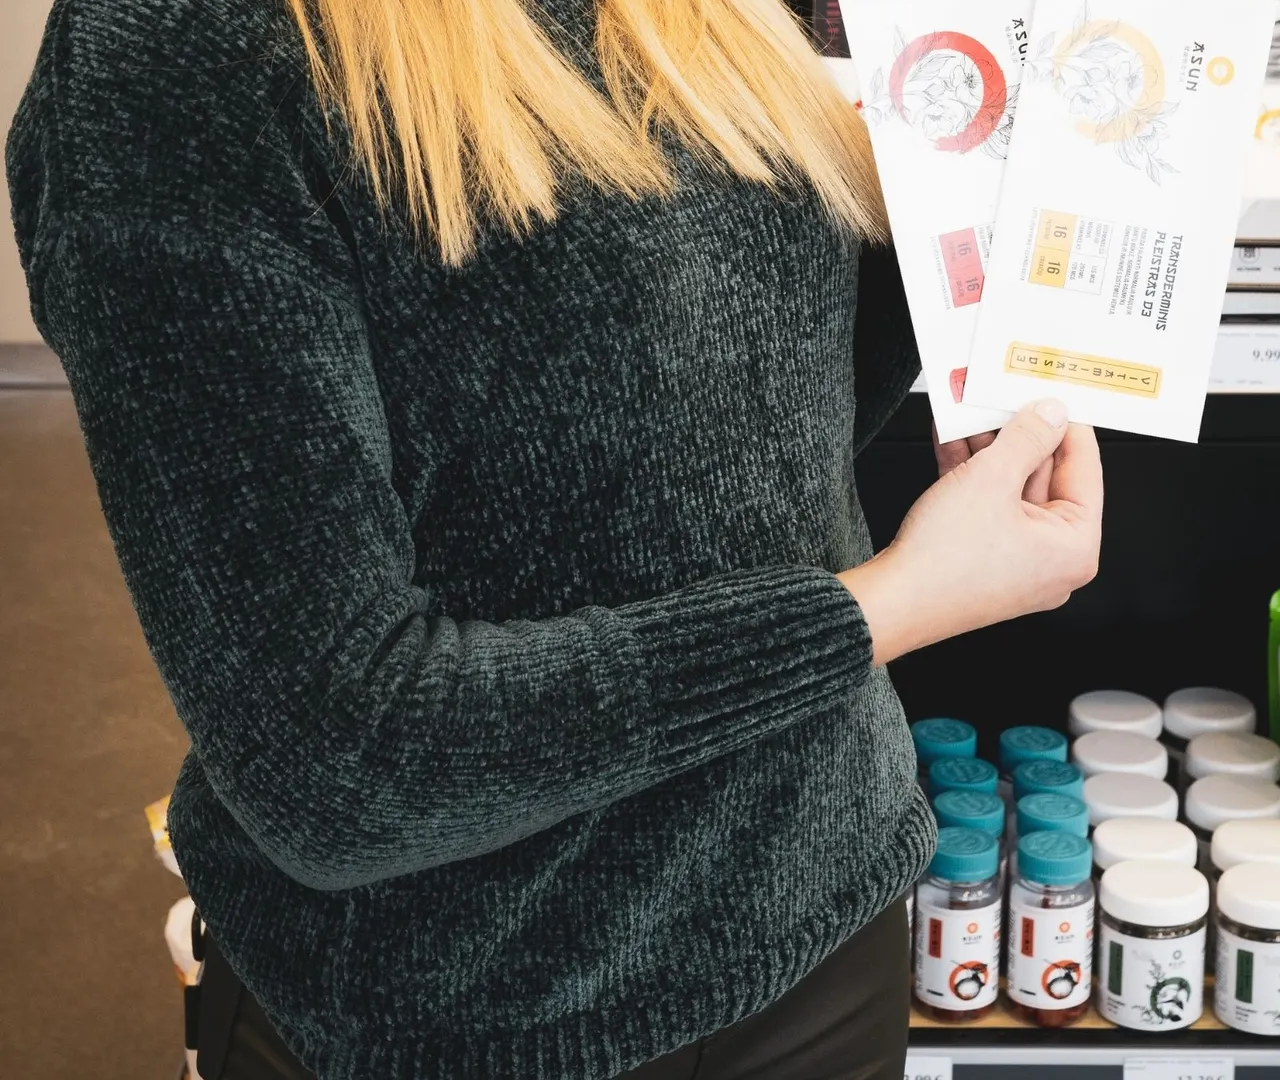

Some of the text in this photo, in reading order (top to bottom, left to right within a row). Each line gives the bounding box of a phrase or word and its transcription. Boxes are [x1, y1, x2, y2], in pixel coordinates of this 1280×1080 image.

[1186, 41, 1205, 92] ASUN
[1053, 224, 1068, 239] 16
[1046, 260, 1061, 275] 16
[1141, 231, 1166, 318] PLEISTRAS D3
[965, 276, 980, 292] 16
[1155, 234, 1183, 332] TRANSDERMINIS
[1252, 349, 1280, 362] 9,99
